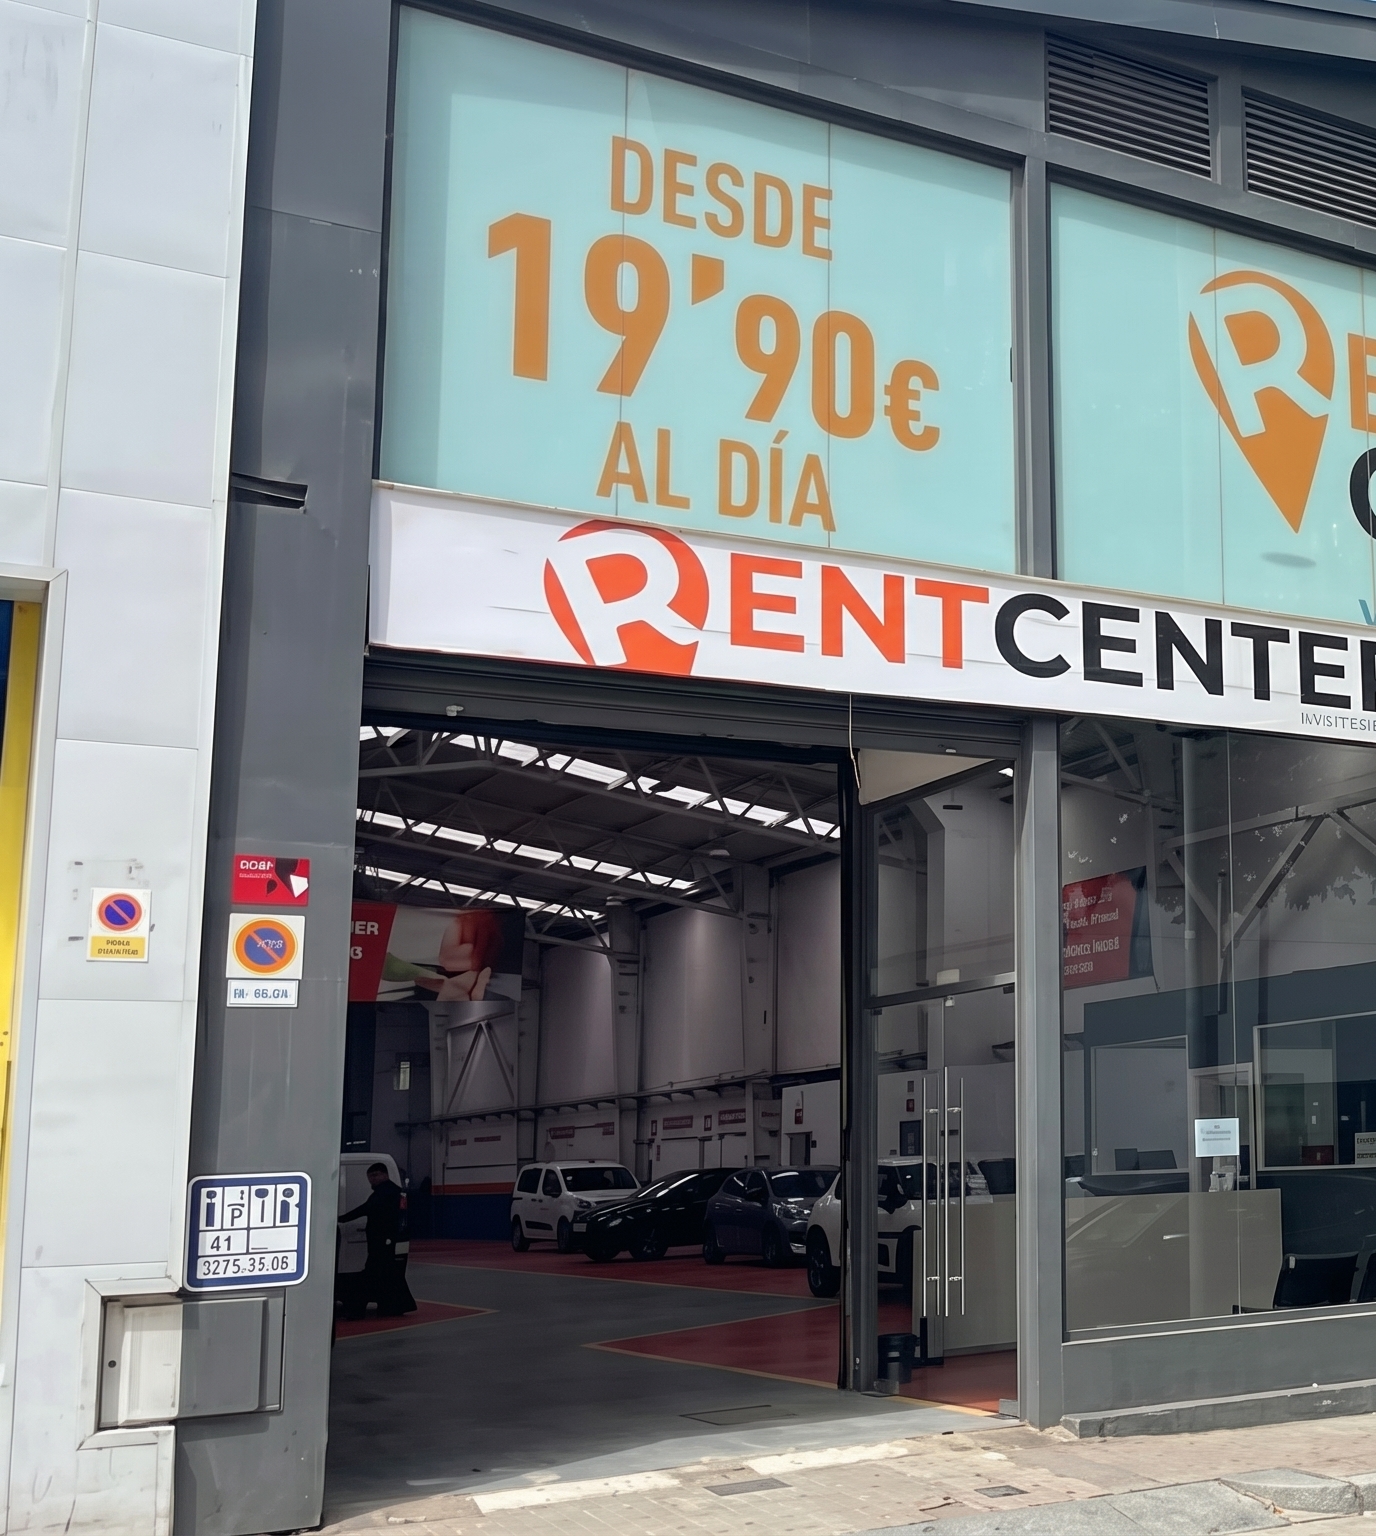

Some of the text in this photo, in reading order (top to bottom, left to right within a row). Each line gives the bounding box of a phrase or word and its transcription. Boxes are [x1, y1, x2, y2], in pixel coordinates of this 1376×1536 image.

[611, 135, 833, 261] DESDE
[596, 421, 836, 532] AL DÍA
[210, 1235, 231, 1251] 41
